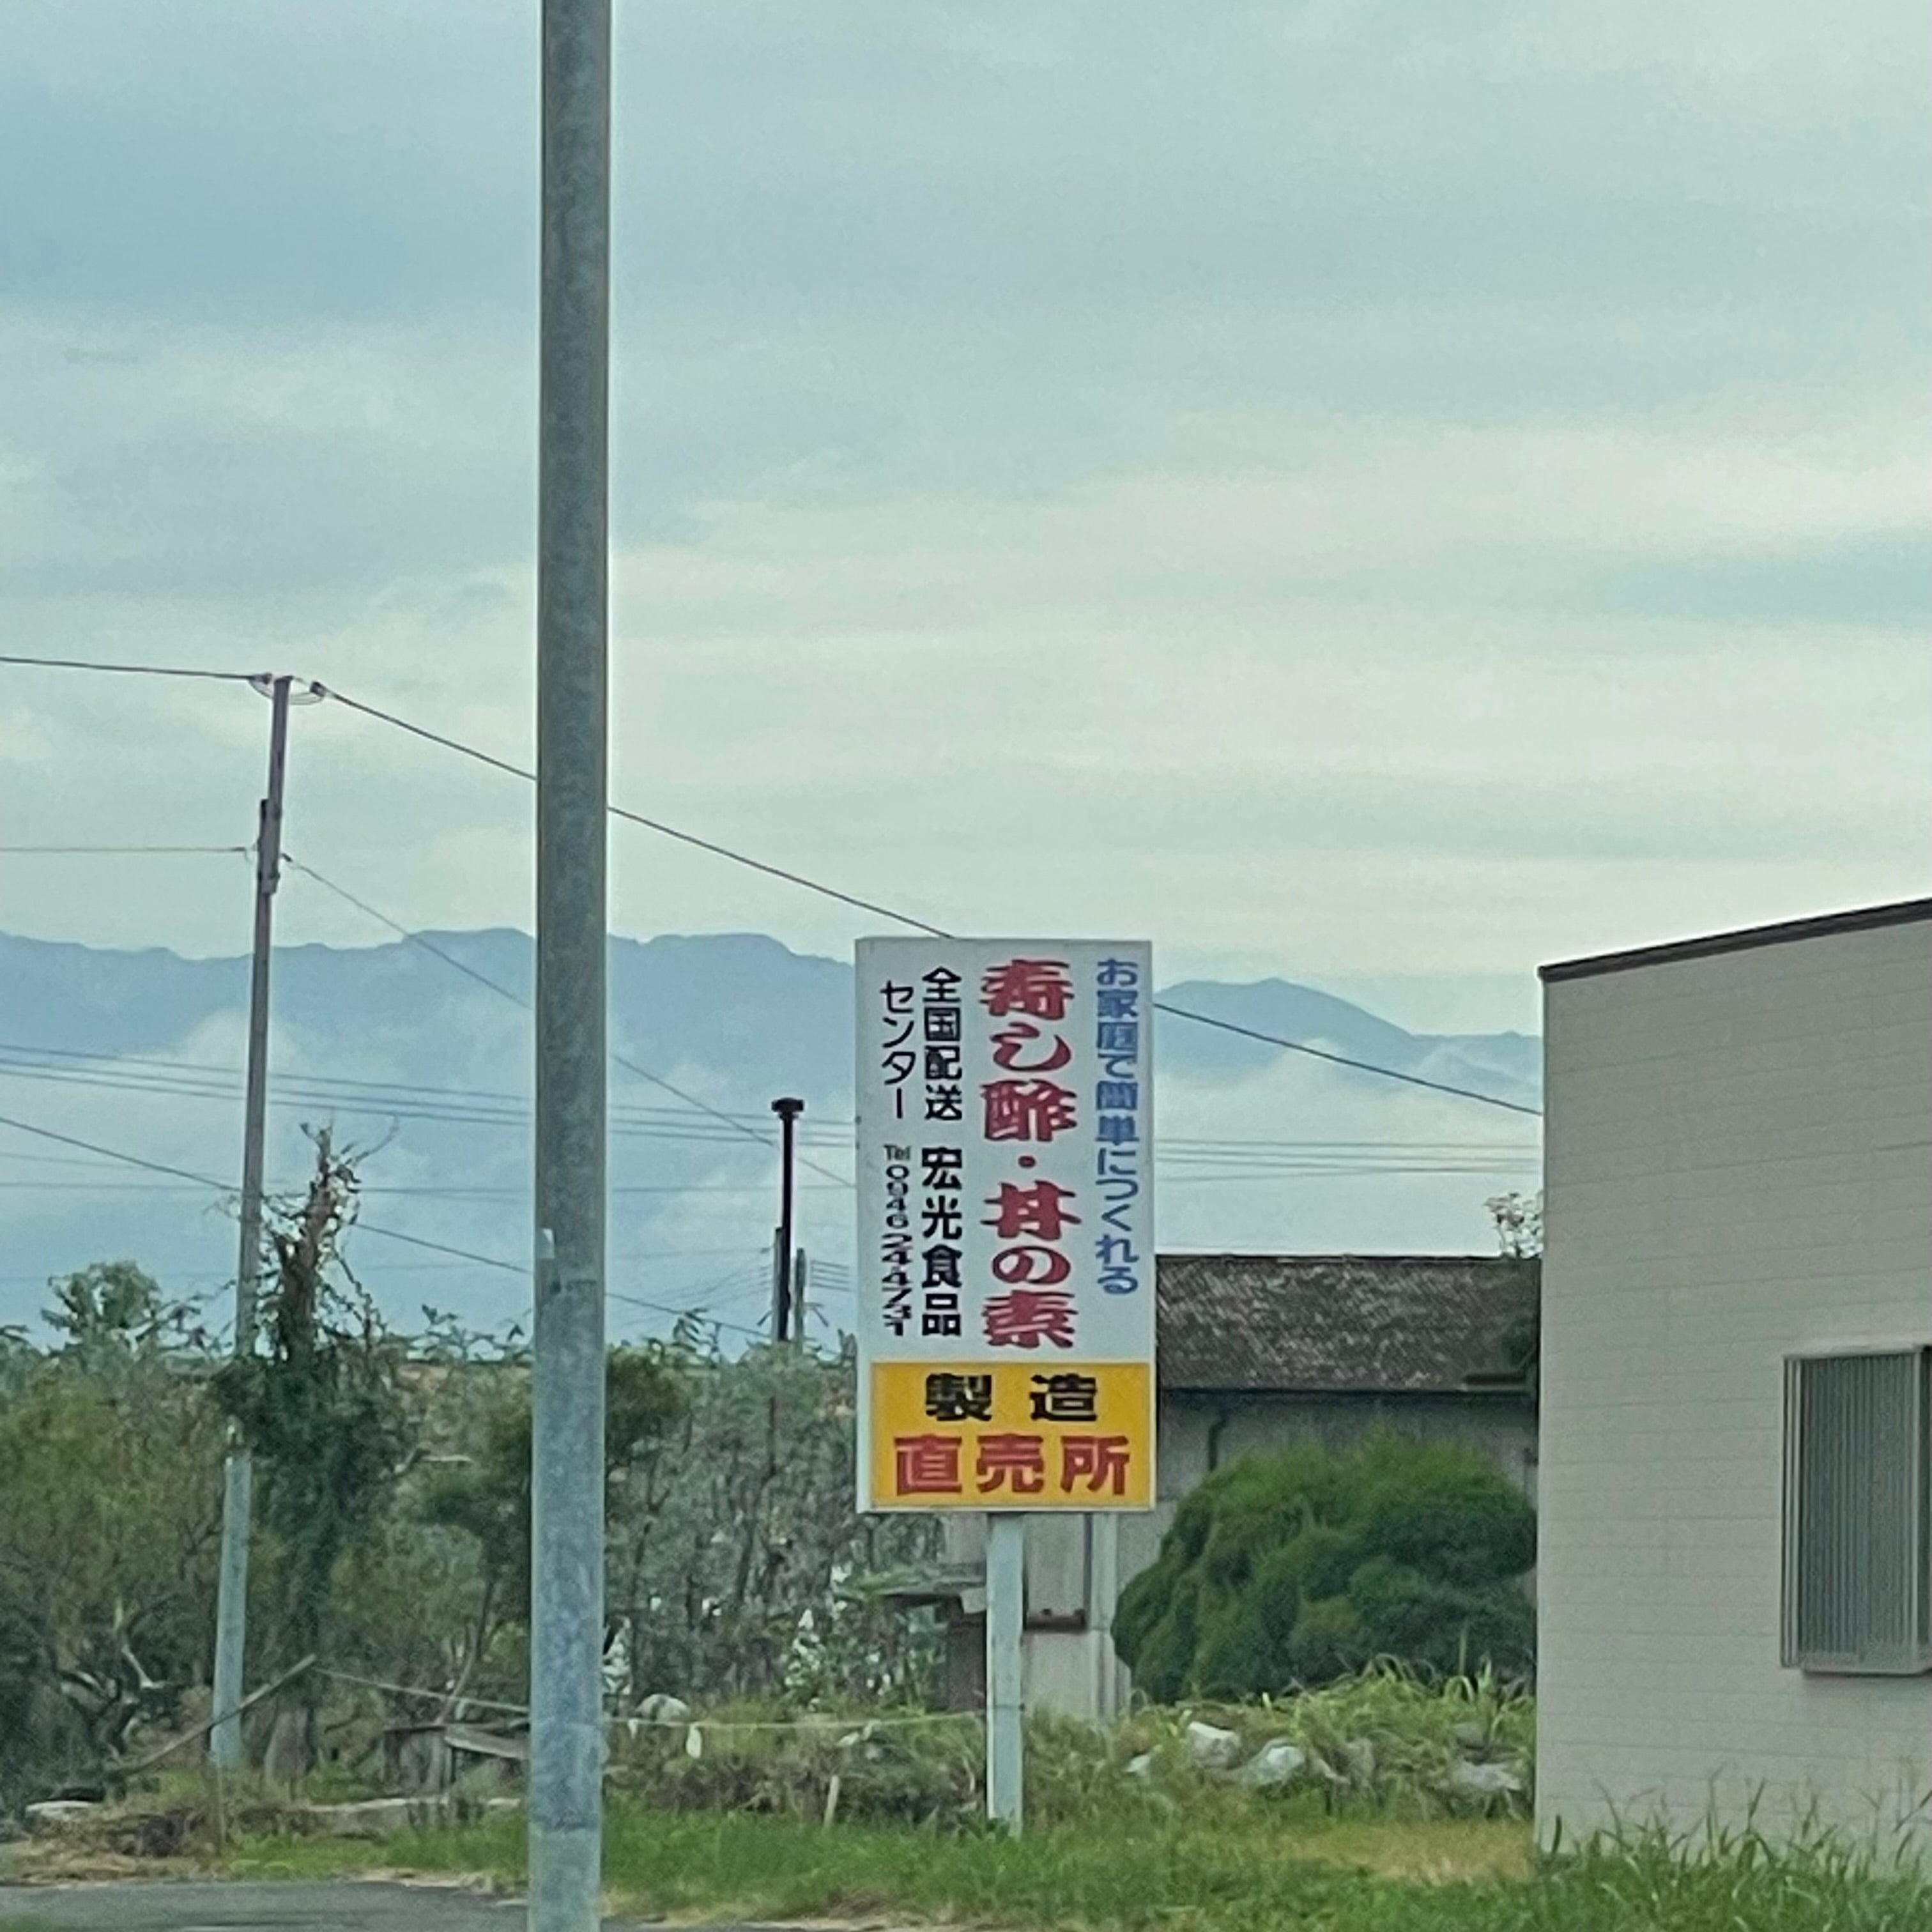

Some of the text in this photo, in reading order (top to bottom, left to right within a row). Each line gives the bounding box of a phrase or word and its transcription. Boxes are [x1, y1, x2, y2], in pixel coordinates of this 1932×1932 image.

[880, 980, 916, 1119] センター
[922, 966, 962, 1336] 全国配送 宏光食品
[1096, 958, 1139, 1294] お家庭で簡単につくれる
[894, 1433, 1130, 1496] 直売所
[926, 1372, 1098, 1422] 製造
